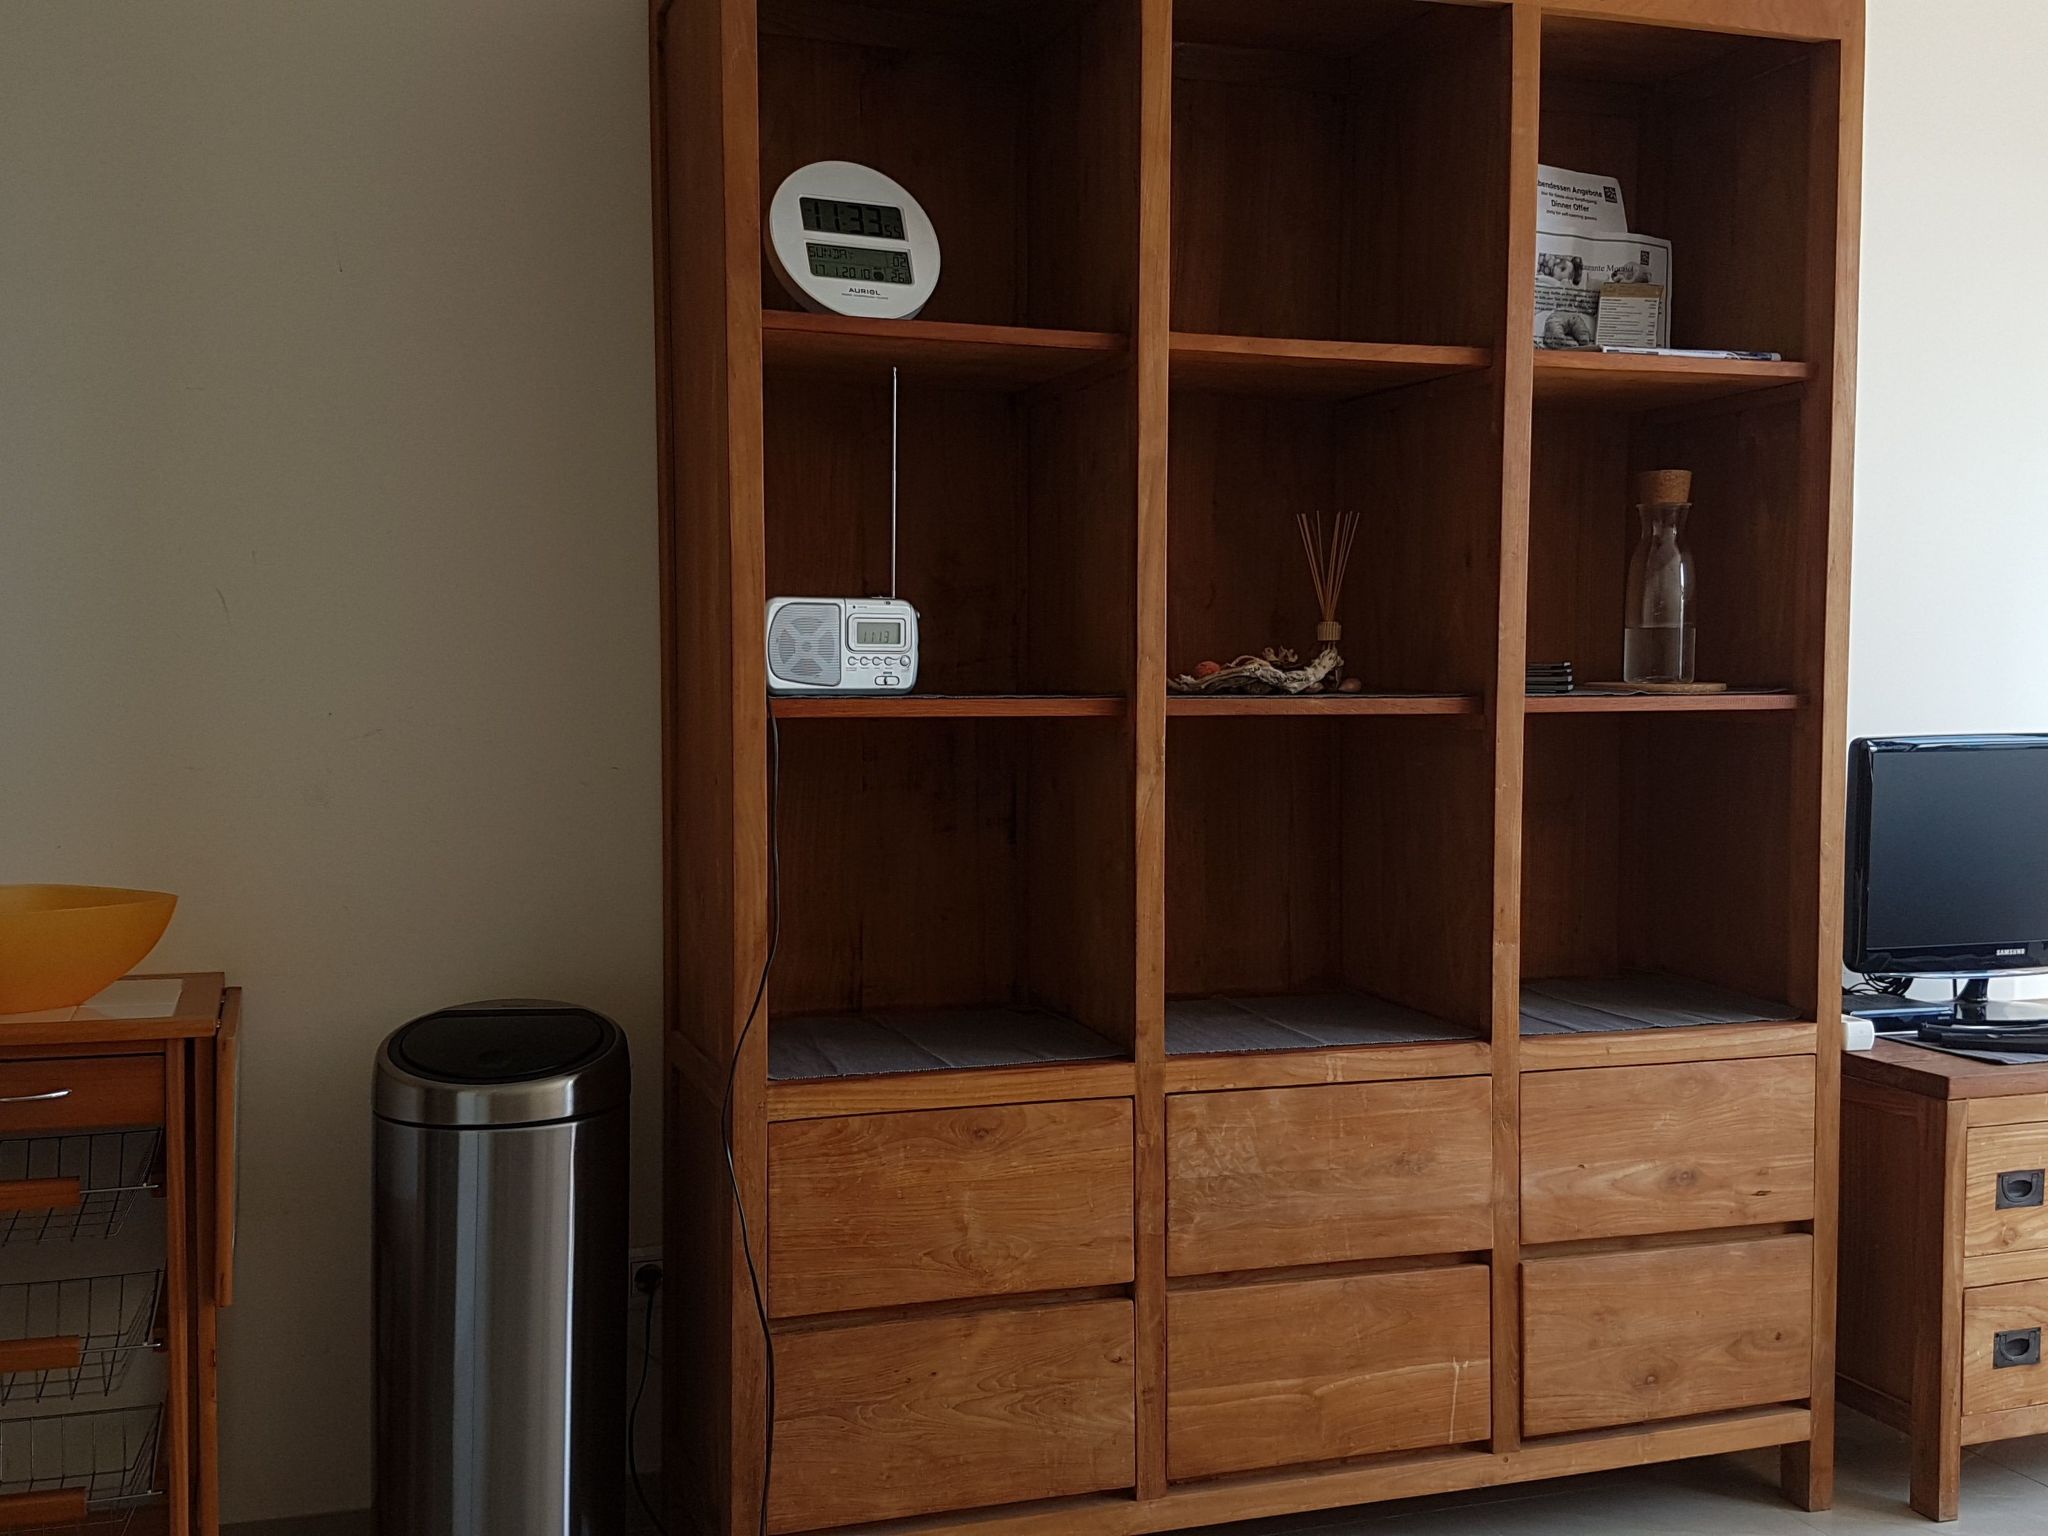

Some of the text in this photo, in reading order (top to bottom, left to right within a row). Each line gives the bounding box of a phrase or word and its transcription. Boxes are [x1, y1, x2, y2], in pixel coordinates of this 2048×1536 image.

[1551, 199, 1590, 212] Dinner Offer
[1996, 948, 2026, 956] SAMSUNG
